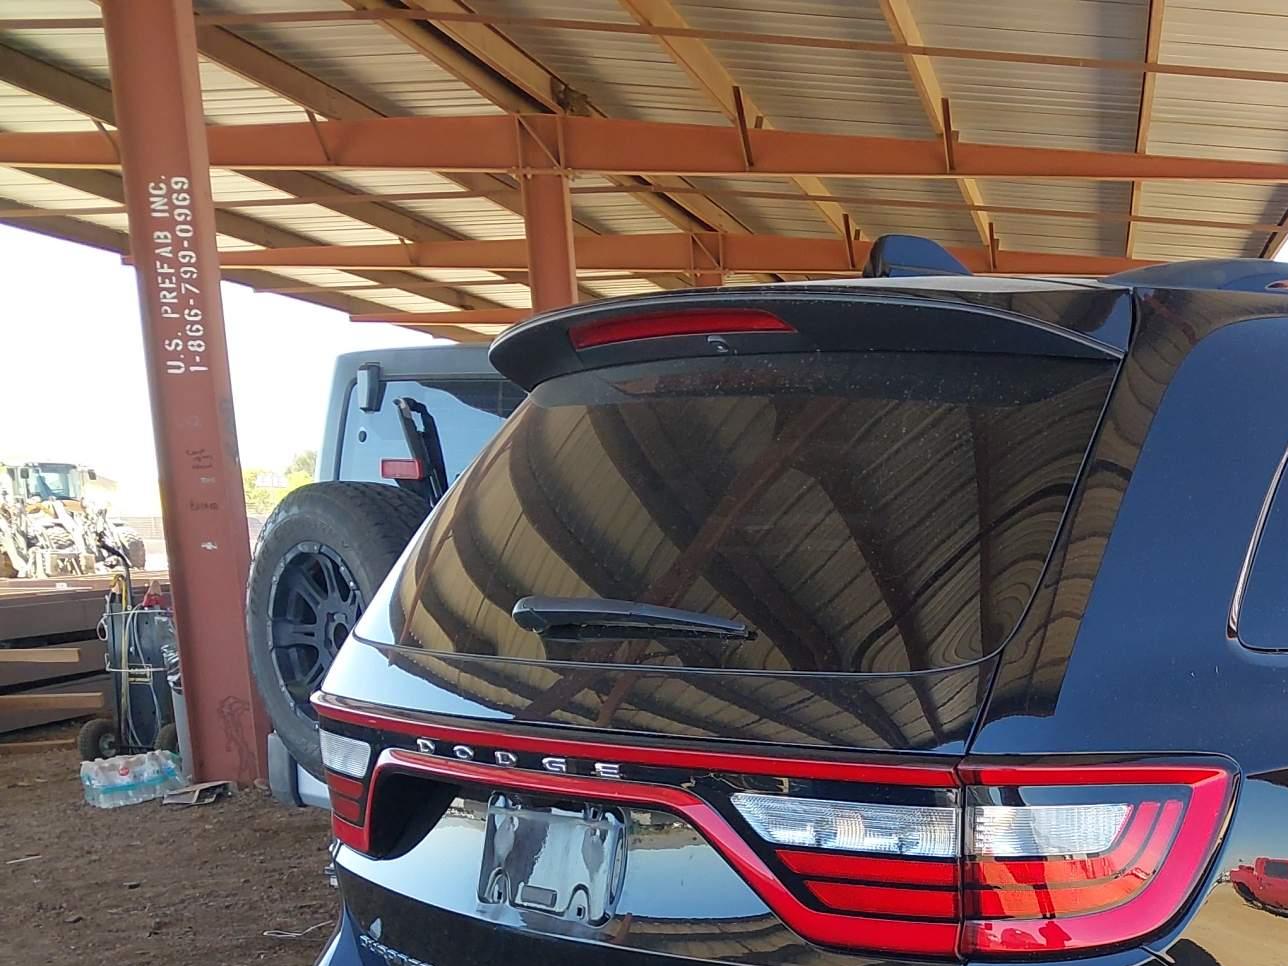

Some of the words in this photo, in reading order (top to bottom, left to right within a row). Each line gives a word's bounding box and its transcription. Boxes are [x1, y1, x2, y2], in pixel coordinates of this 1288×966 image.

[149, 175, 170, 217] INC.
[153, 230, 180, 318] PREFAB
[171, 176, 209, 372] 1-866-799-0969
[165, 332, 186, 374] U.S.
[416, 738, 621, 778] DODGE
